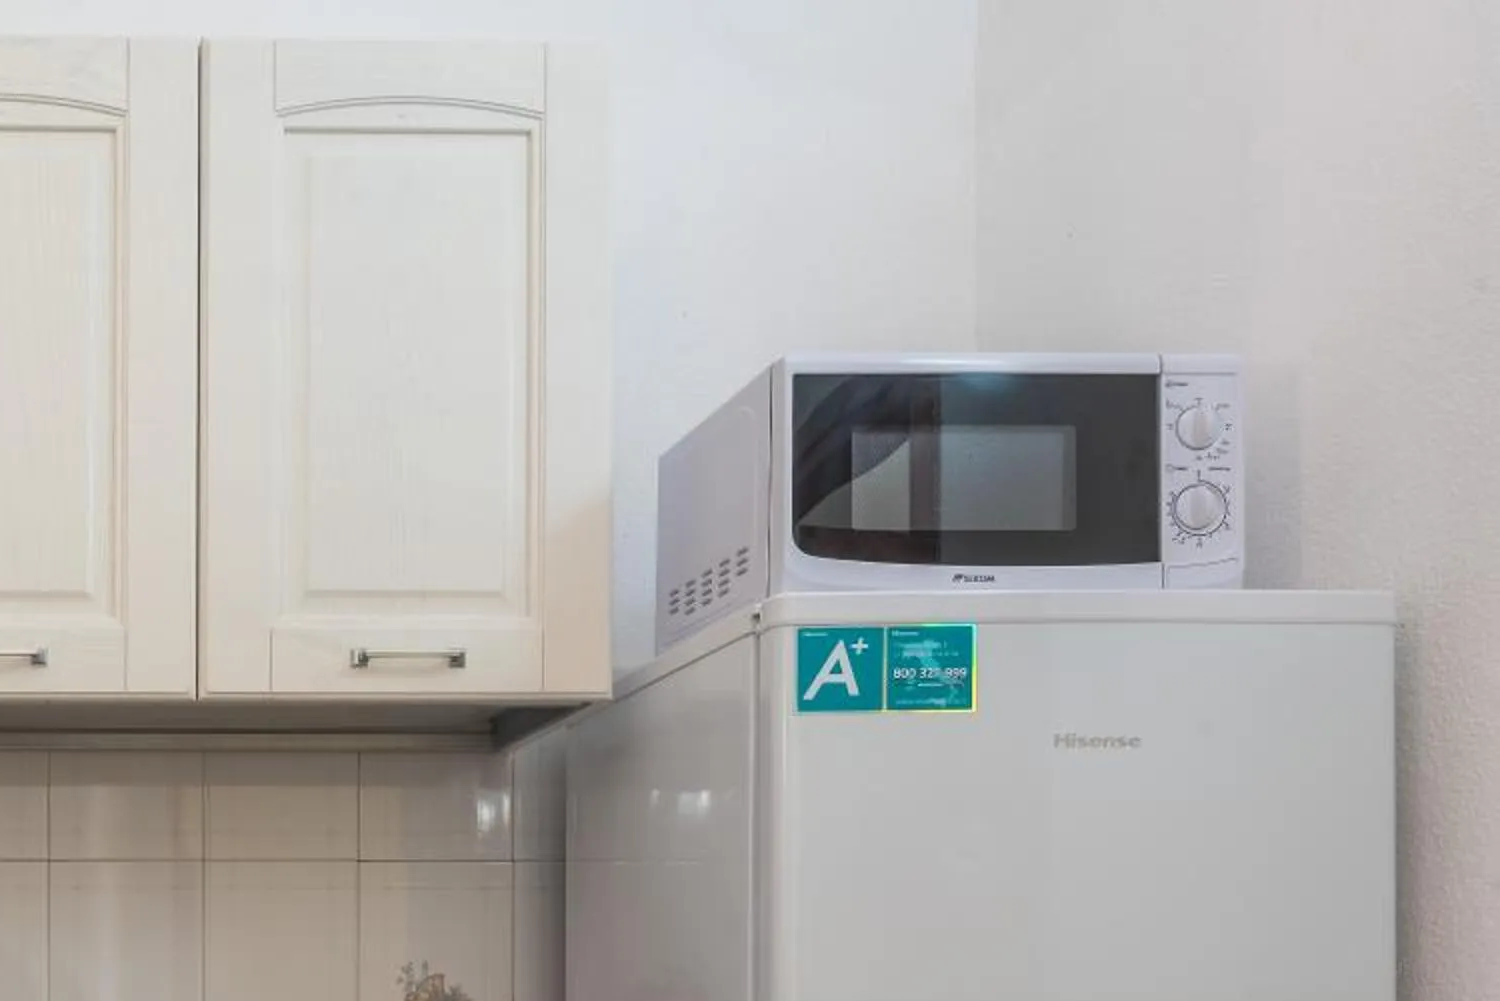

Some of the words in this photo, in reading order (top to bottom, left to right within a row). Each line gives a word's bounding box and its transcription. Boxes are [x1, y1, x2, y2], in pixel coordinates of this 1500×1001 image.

[893, 667, 917, 679] 800
[919, 667, 942, 679] 32
[1053, 732, 1143, 749] Hisense
